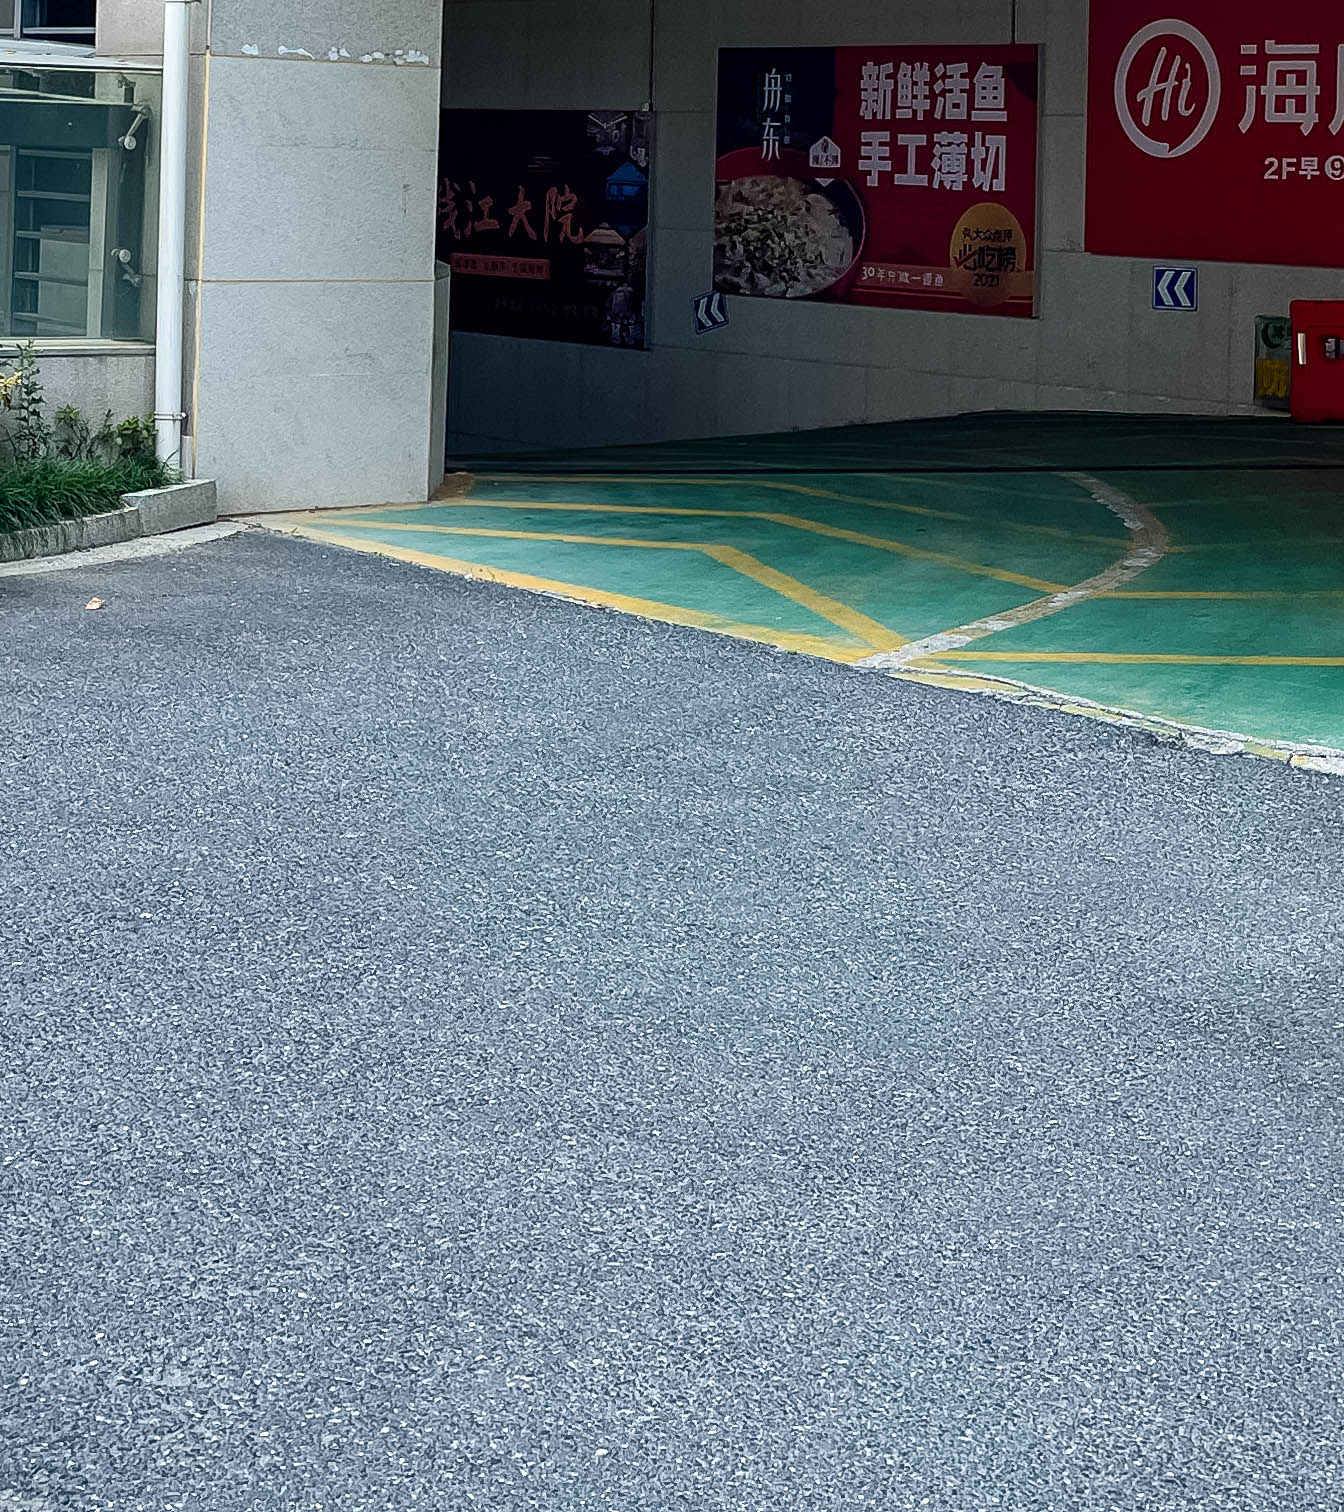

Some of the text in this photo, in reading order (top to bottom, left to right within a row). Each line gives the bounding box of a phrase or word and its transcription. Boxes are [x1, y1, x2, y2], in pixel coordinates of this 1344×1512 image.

[859, 61, 1008, 122] 新鲜活鱼
[858, 130, 1008, 192] 手工薄切
[953, 243, 1016, 273] 必吃榜
[972, 273, 1001, 288] 2021
